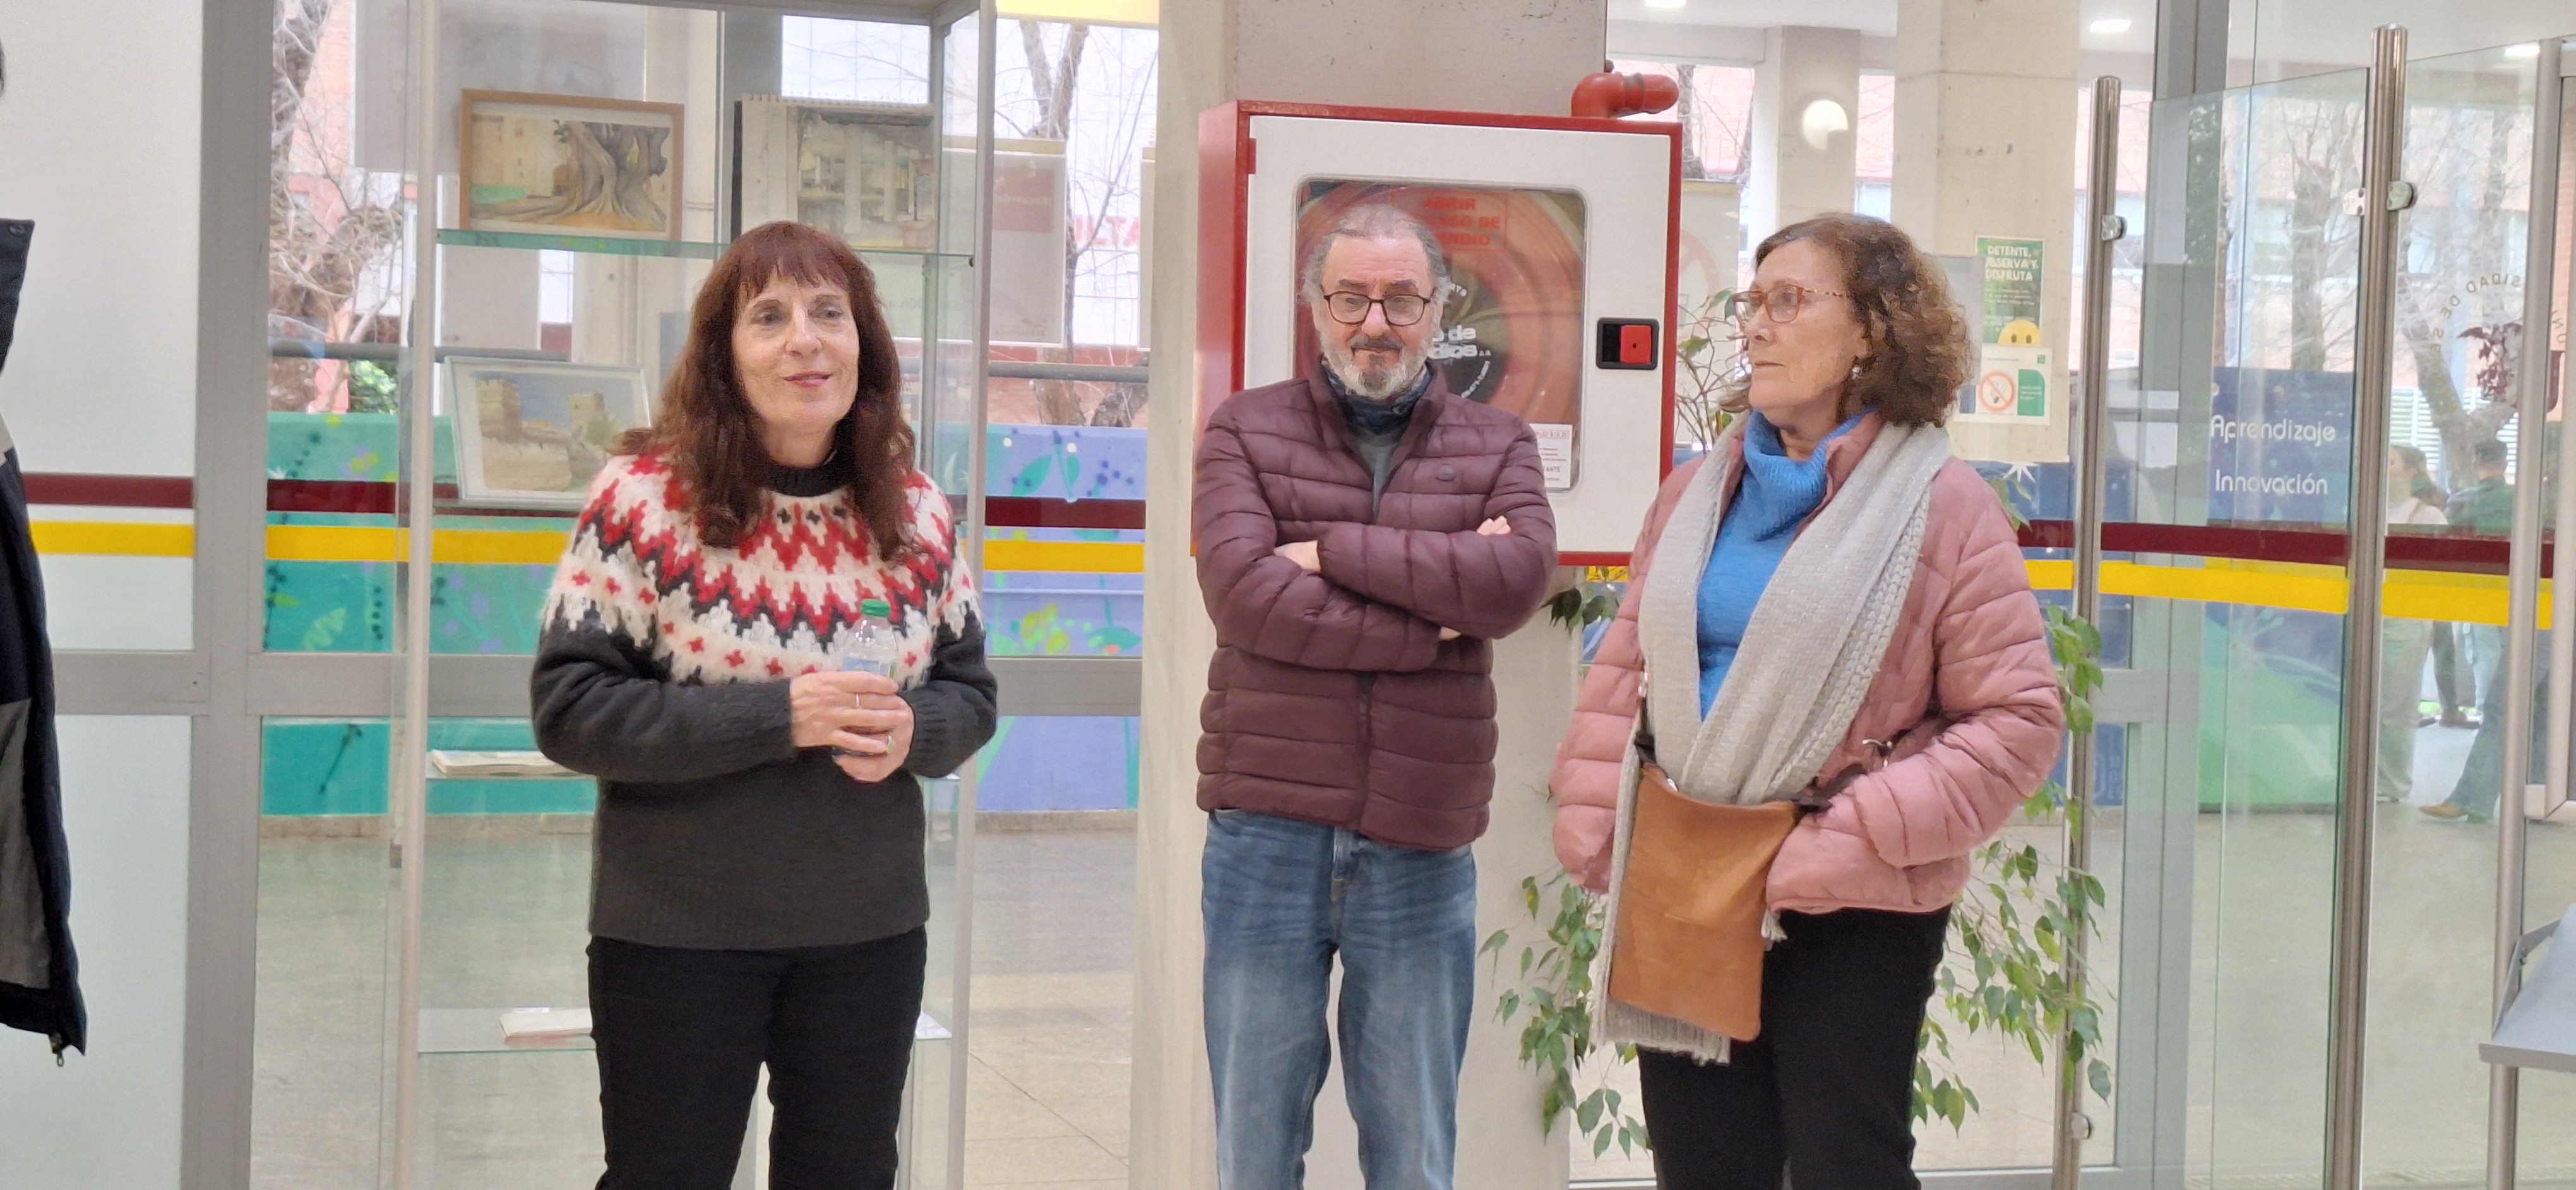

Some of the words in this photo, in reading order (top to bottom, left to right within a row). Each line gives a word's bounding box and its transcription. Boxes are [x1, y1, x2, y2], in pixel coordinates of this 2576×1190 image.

[1424, 197, 1476, 210] ABRIR
[1427, 215, 1474, 228] CASO
[1479, 217, 1500, 229] DE
[1988, 245, 2031, 258] DETENTE,
[1986, 269, 2033, 282] DISFRUTA
[2210, 414, 2335, 447] Aprendizaje
[2215, 469, 2329, 495] Innovación
